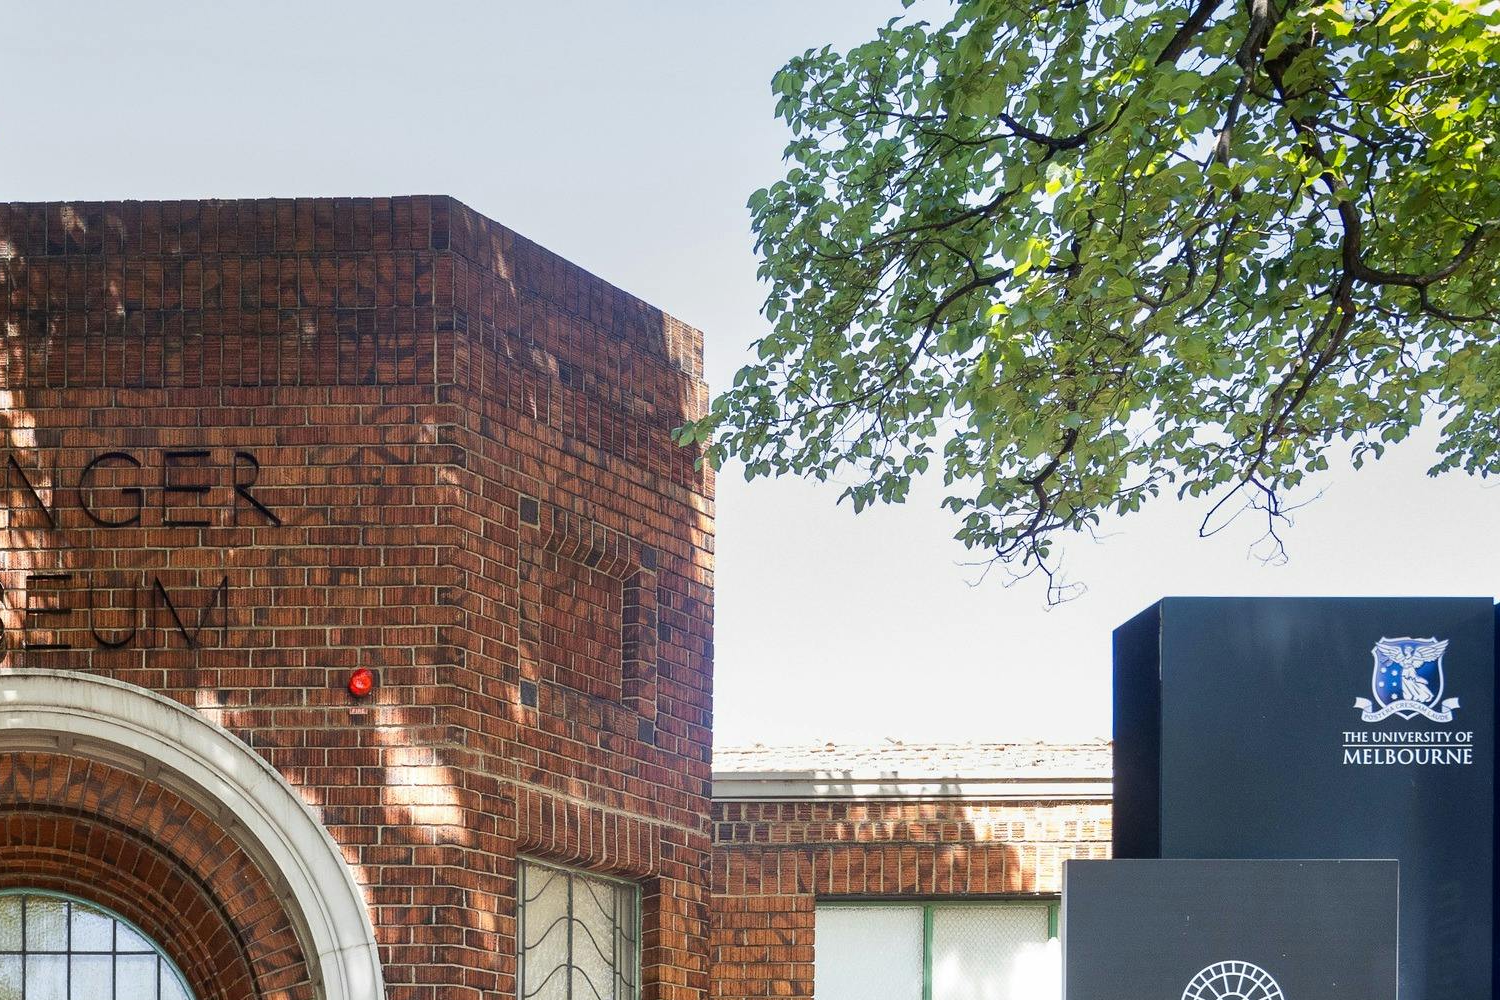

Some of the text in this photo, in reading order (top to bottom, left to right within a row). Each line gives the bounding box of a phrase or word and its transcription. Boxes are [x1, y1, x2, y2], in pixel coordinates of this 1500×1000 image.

[1342, 731, 1473, 743] THE UNIVERSITY OF
[1343, 748, 1473, 765] MELBOURNE
